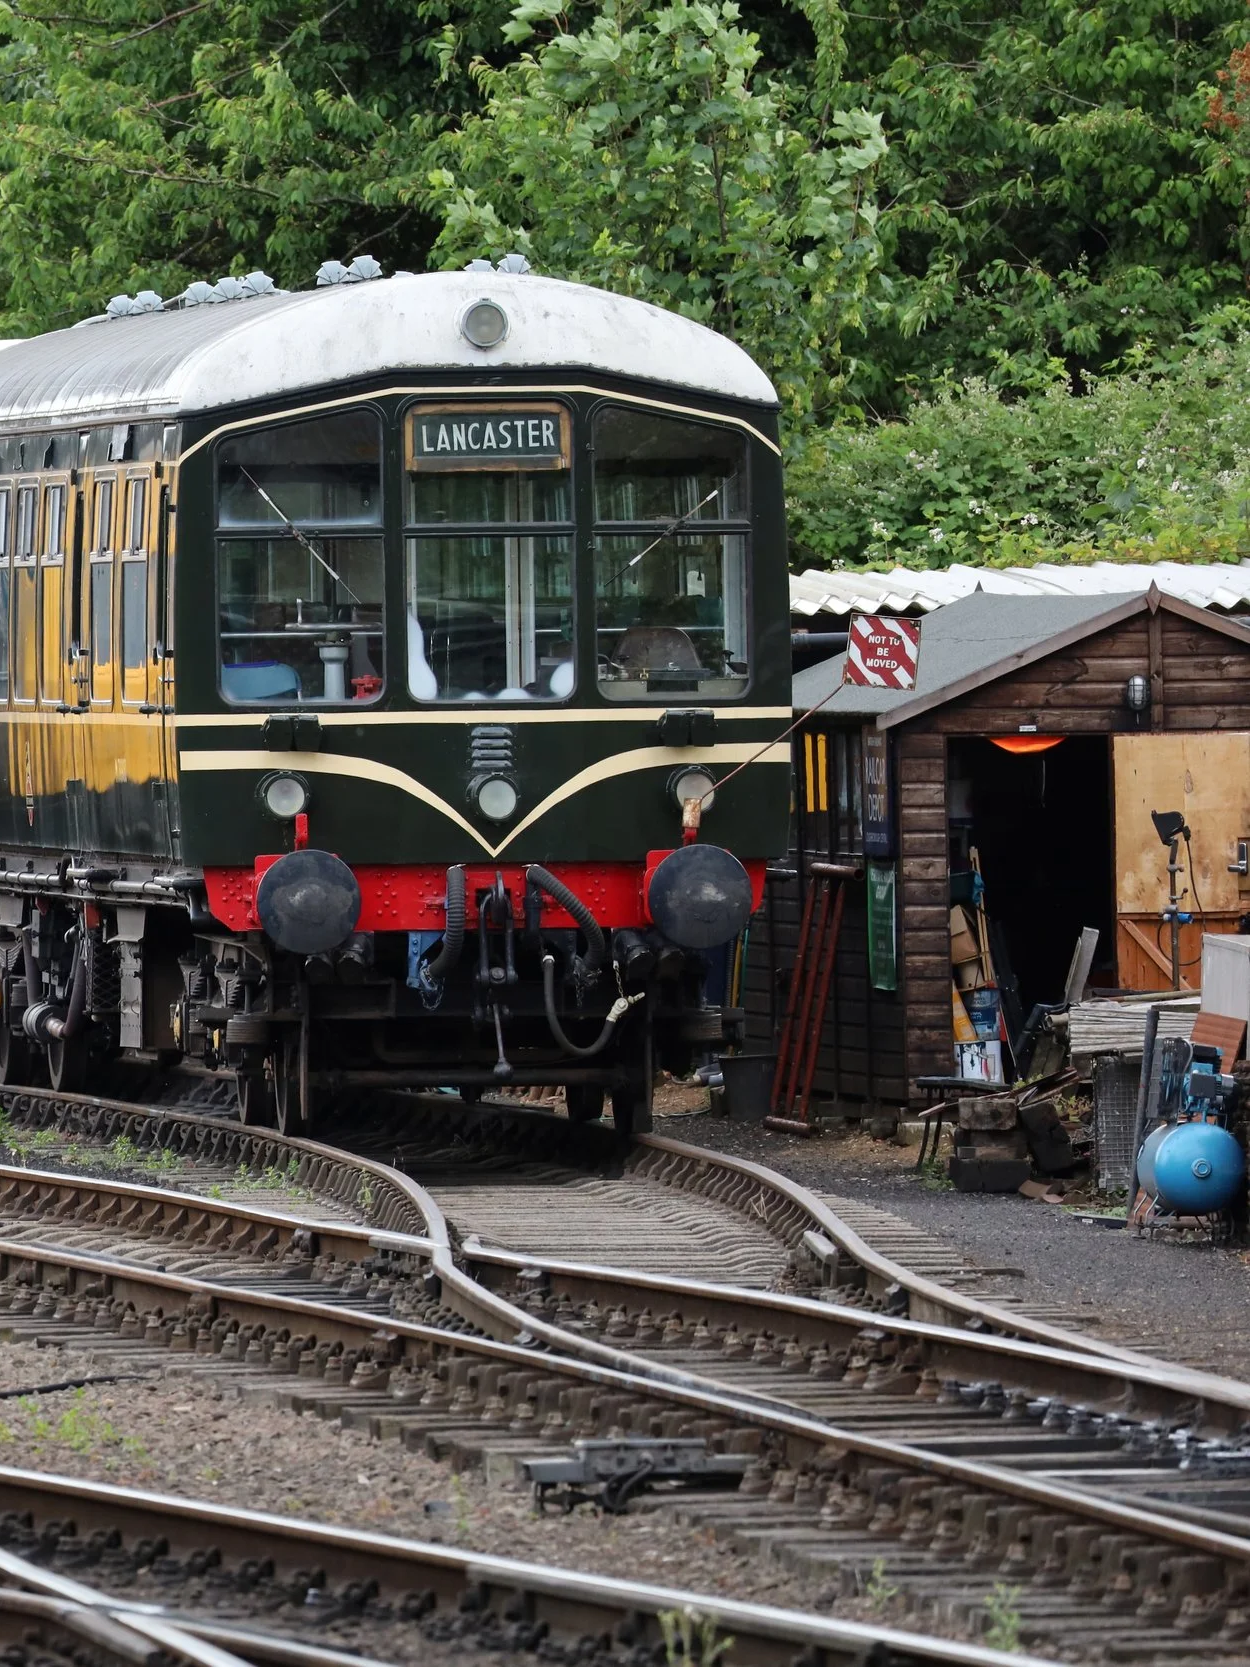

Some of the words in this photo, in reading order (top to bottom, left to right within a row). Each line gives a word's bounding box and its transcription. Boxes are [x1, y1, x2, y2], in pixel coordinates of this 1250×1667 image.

[421, 419, 555, 452] LANCASTER
[868, 635, 886, 645] NOT
[889, 636, 900, 646] TO
[876, 647, 889, 657] BE
[866, 658, 898, 669] MOVED
